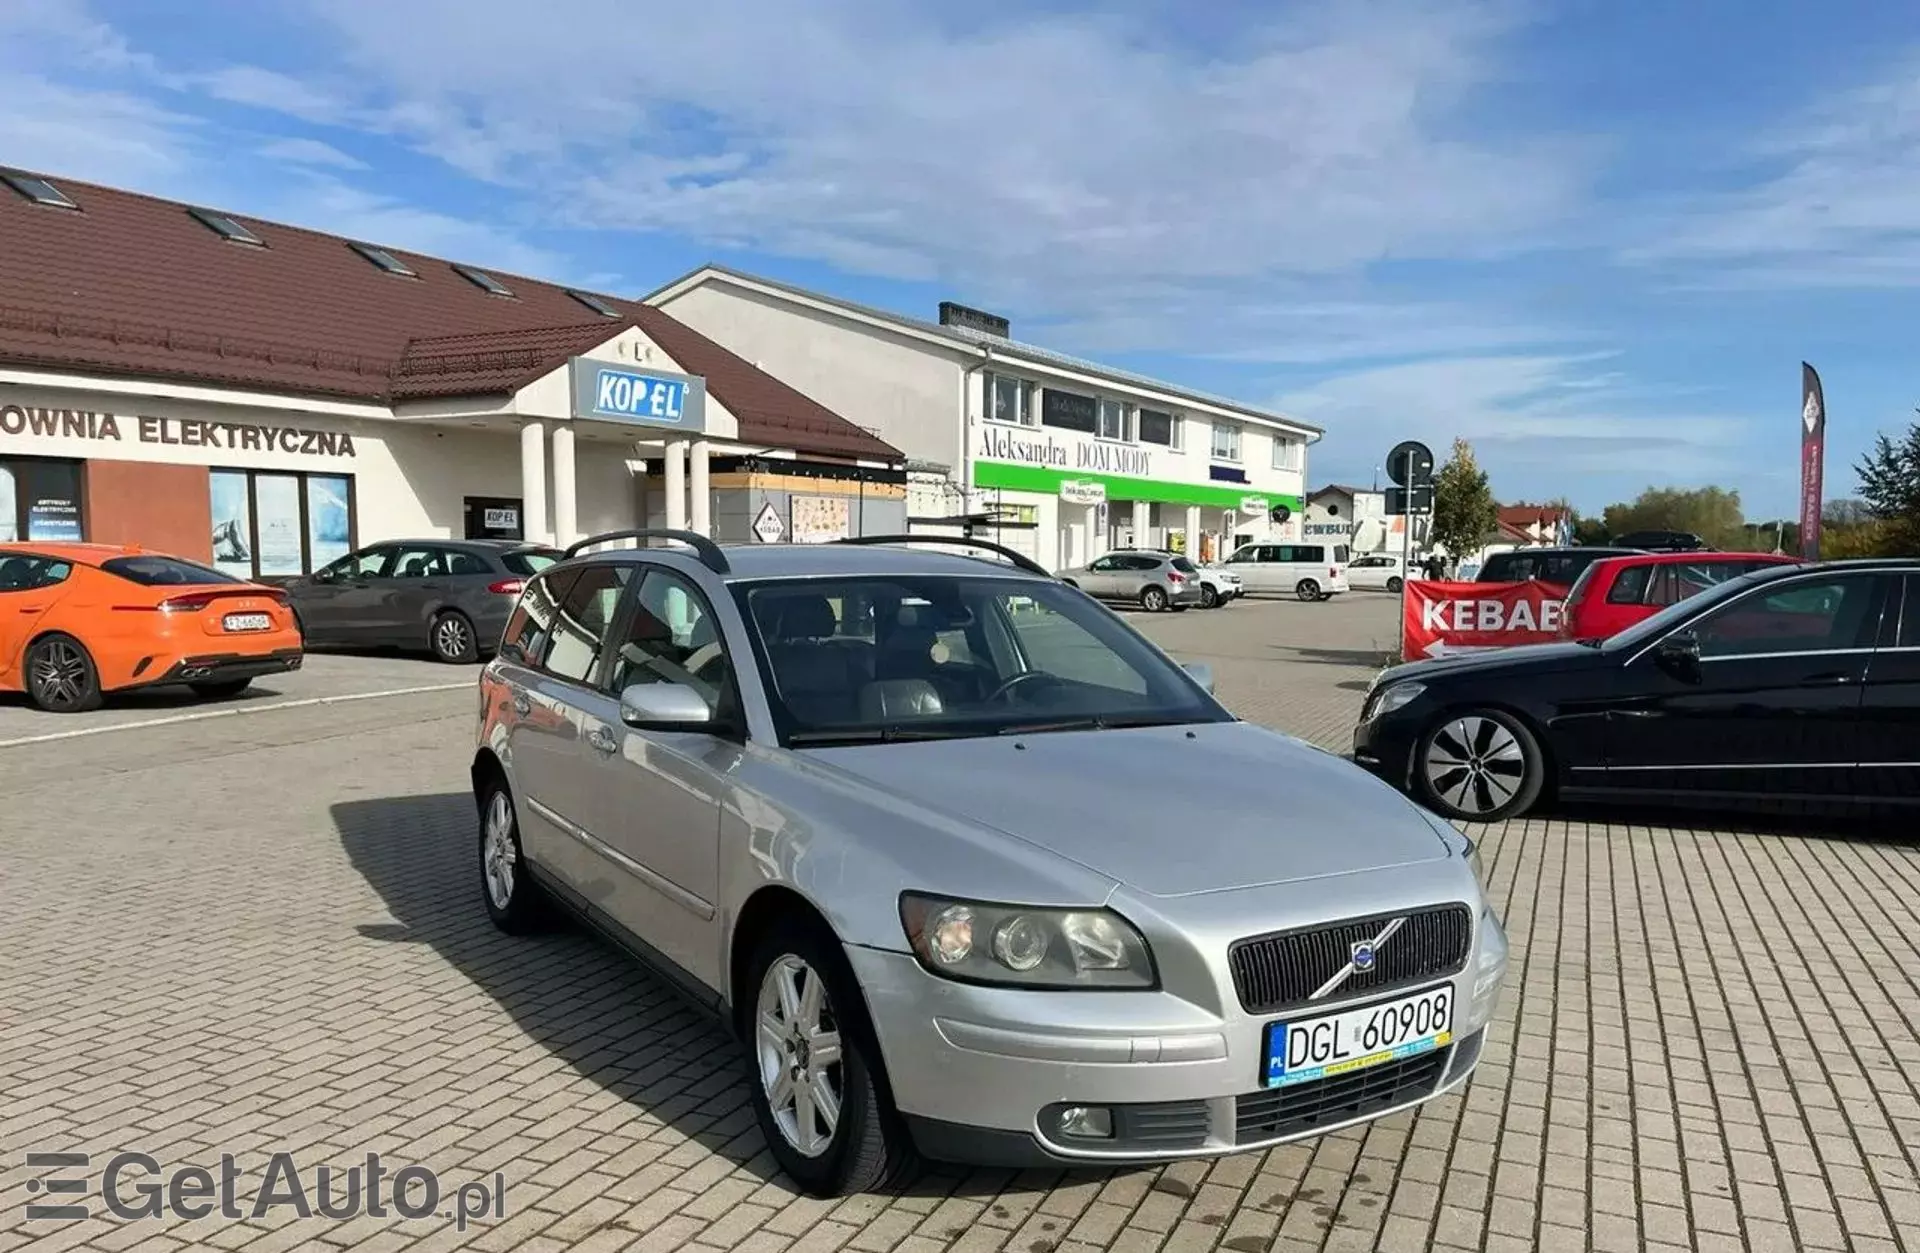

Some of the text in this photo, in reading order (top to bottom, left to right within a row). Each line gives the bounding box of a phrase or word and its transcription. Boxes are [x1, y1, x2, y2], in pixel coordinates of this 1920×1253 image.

[138, 415, 356, 457] ELEKTRYCZNA
[980, 428, 1152, 476] Aleksandra DOM MODY
[1288, 1019, 1350, 1068] DGL
[1363, 993, 1447, 1051] 60908
[1270, 1056, 1283, 1069] PL
